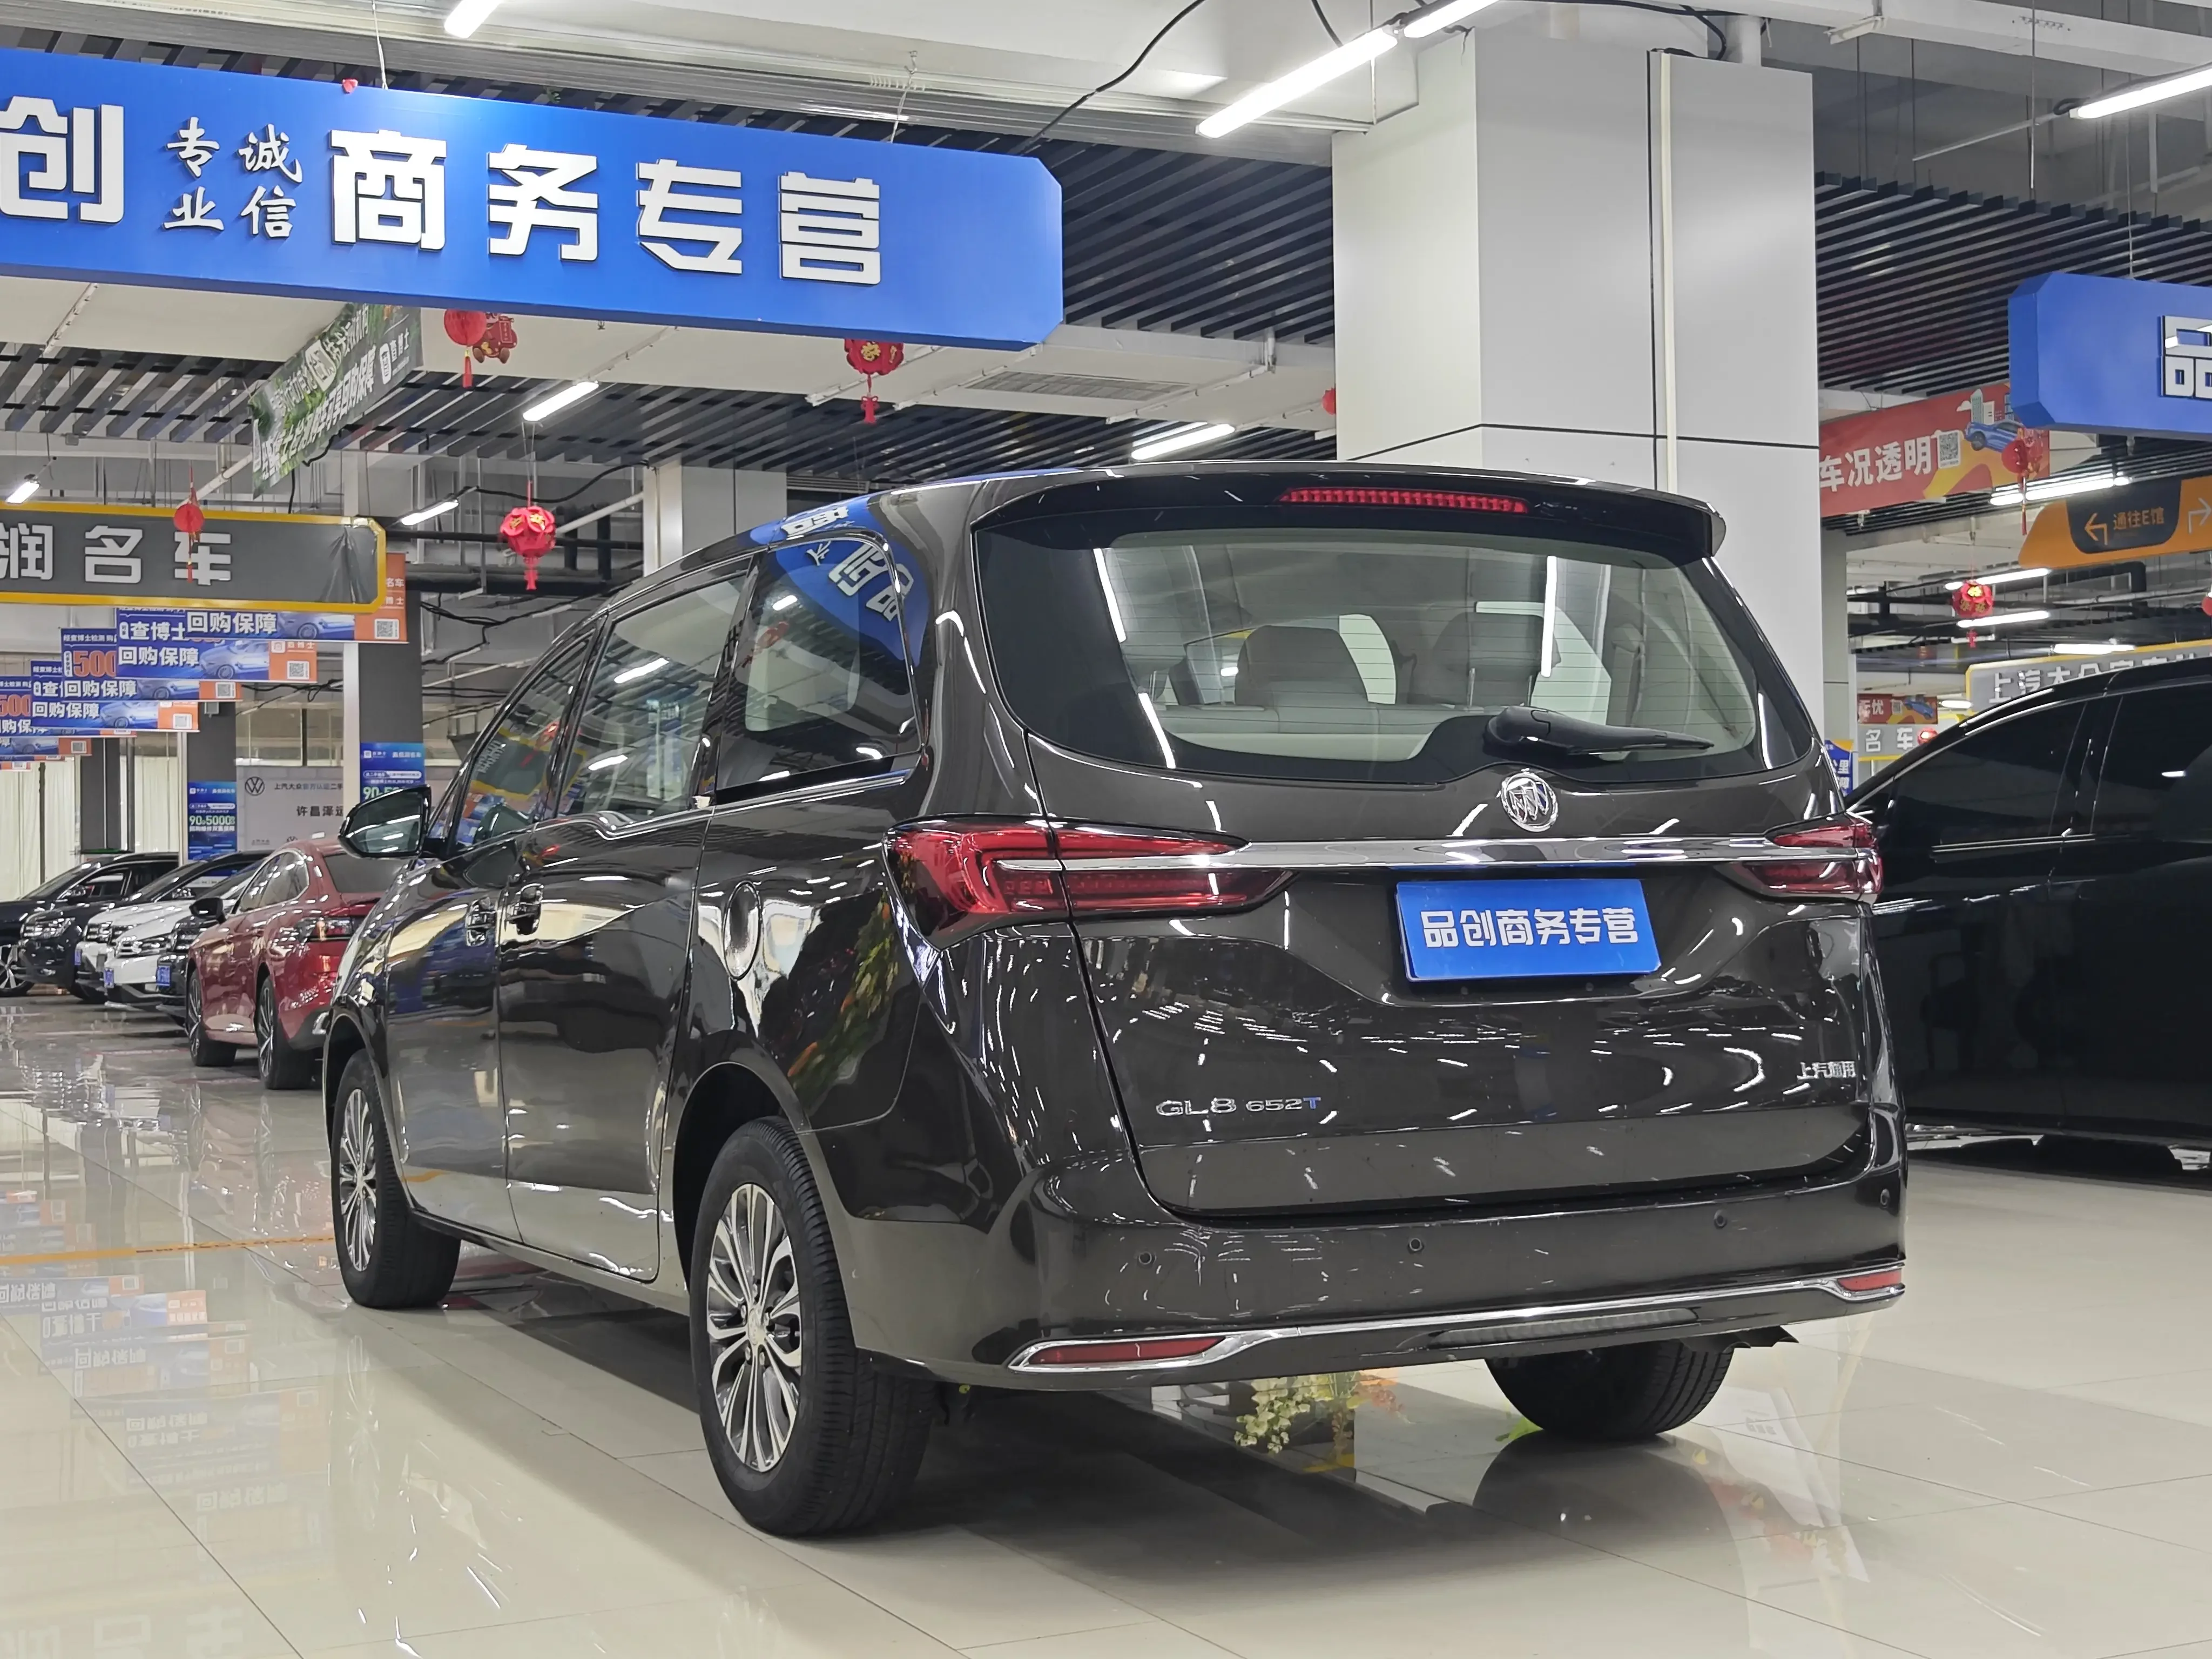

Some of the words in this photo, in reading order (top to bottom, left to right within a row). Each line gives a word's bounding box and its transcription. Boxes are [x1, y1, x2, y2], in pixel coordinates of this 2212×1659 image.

[0, 96, 125, 225] 创
[331, 130, 881, 285] 商务专营
[1819, 435, 1932, 493] 车况透明
[2113, 506, 2164, 530] 通往E馆
[0, 522, 231, 585] 润名车
[131, 621, 189, 641] 查博士
[187, 612, 277, 634] 回购保障
[118, 646, 199, 667] 回购保障
[64, 679, 137, 698] 回购保障
[32, 702, 99, 719] 回购保障
[2, 719, 48, 734] 购保
[1865, 727, 1913, 753] 名车
[1420, 907, 1638, 948] 品创商务专营
[1156, 1097, 1237, 1116] GL8
[1246, 1097, 1321, 1111] 652T
